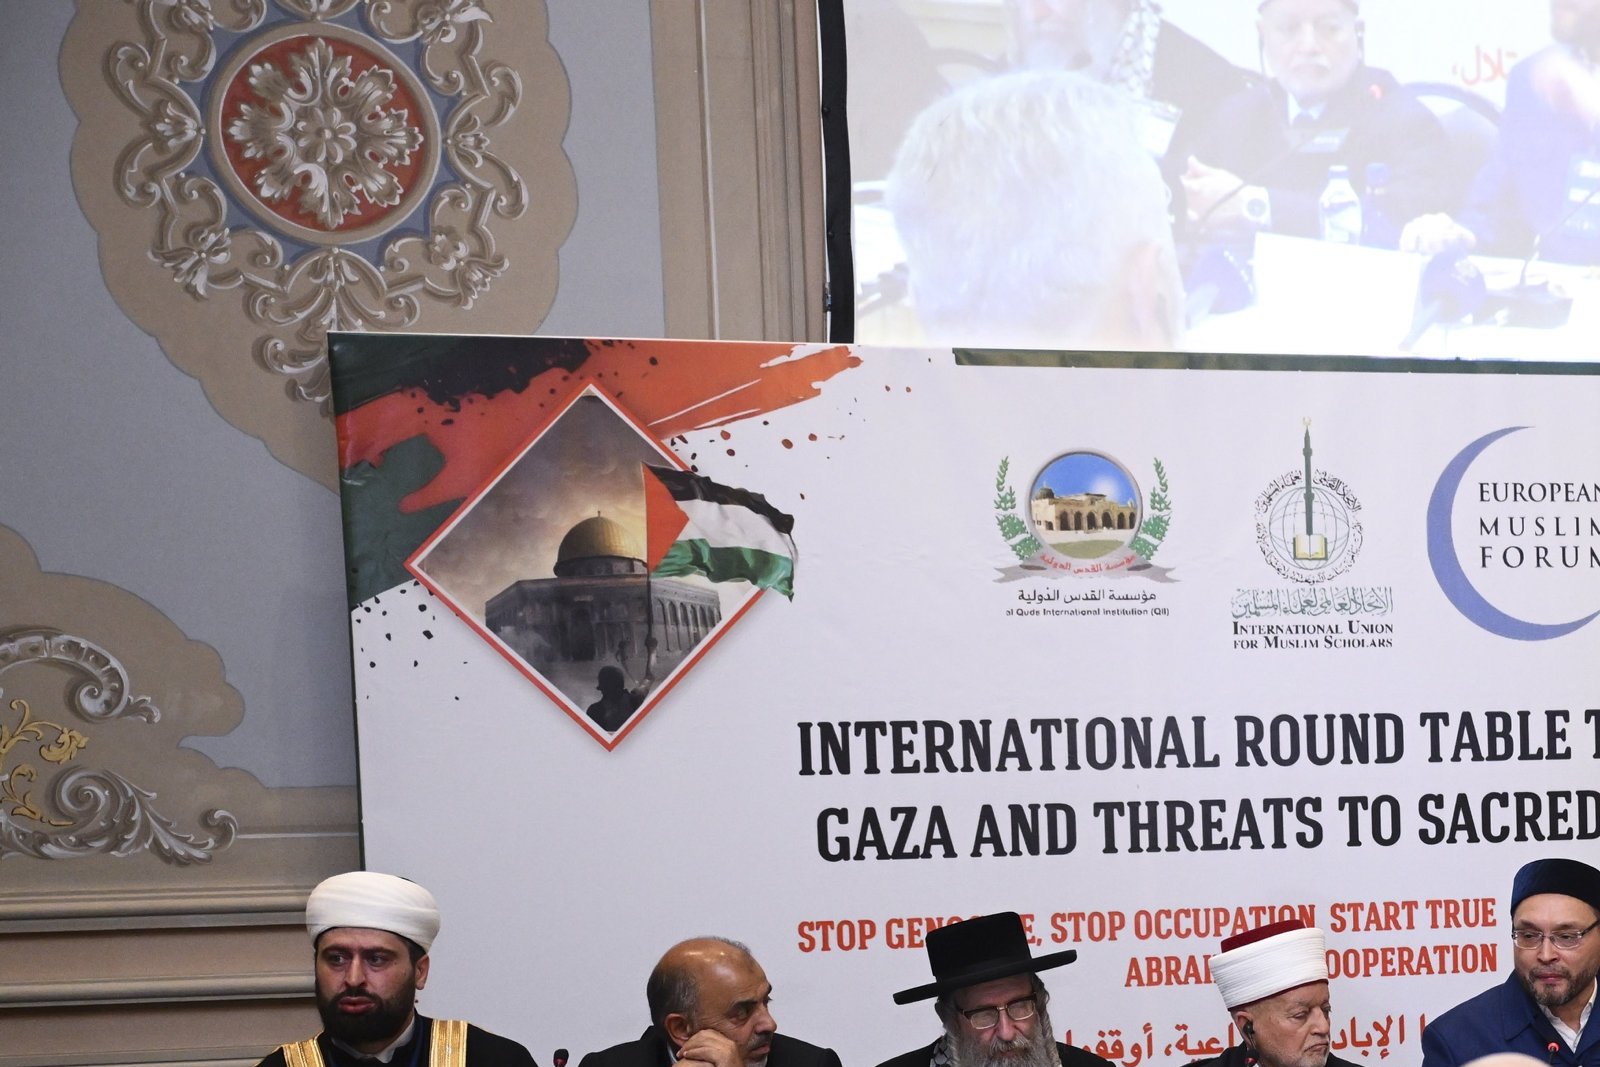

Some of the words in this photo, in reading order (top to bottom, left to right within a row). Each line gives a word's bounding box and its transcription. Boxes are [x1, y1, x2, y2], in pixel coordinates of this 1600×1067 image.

[1019, 587, 1059, 604] الدولية
[1064, 590, 1104, 603] القدس
[1109, 590, 1156, 604] مؤسسة
[1043, 608, 1100, 616] International
[1233, 621, 1342, 634] INTERNATIONAL
[1348, 620, 1392, 634] UNION
[1264, 636, 1318, 648] MUSLIM
[1324, 636, 1392, 648] SCHOLARS
[797, 716, 1220, 776] INTERNATIONAL
[1235, 713, 1404, 767] ROUND
[1420, 710, 1571, 763] TABLE
[817, 805, 957, 862] GAZA
[970, 803, 1076, 857] AND
[1093, 797, 1323, 854] THREATS
[1338, 795, 1401, 847] TO
[798, 919, 877, 953] STOP
[1051, 911, 1126, 943] STOP
[1330, 901, 1419, 932] START
[1426, 898, 1497, 928] TRUE
[1325, 944, 1497, 979] OOPERATION
[1331, 1014, 1405, 1059] الإباد
